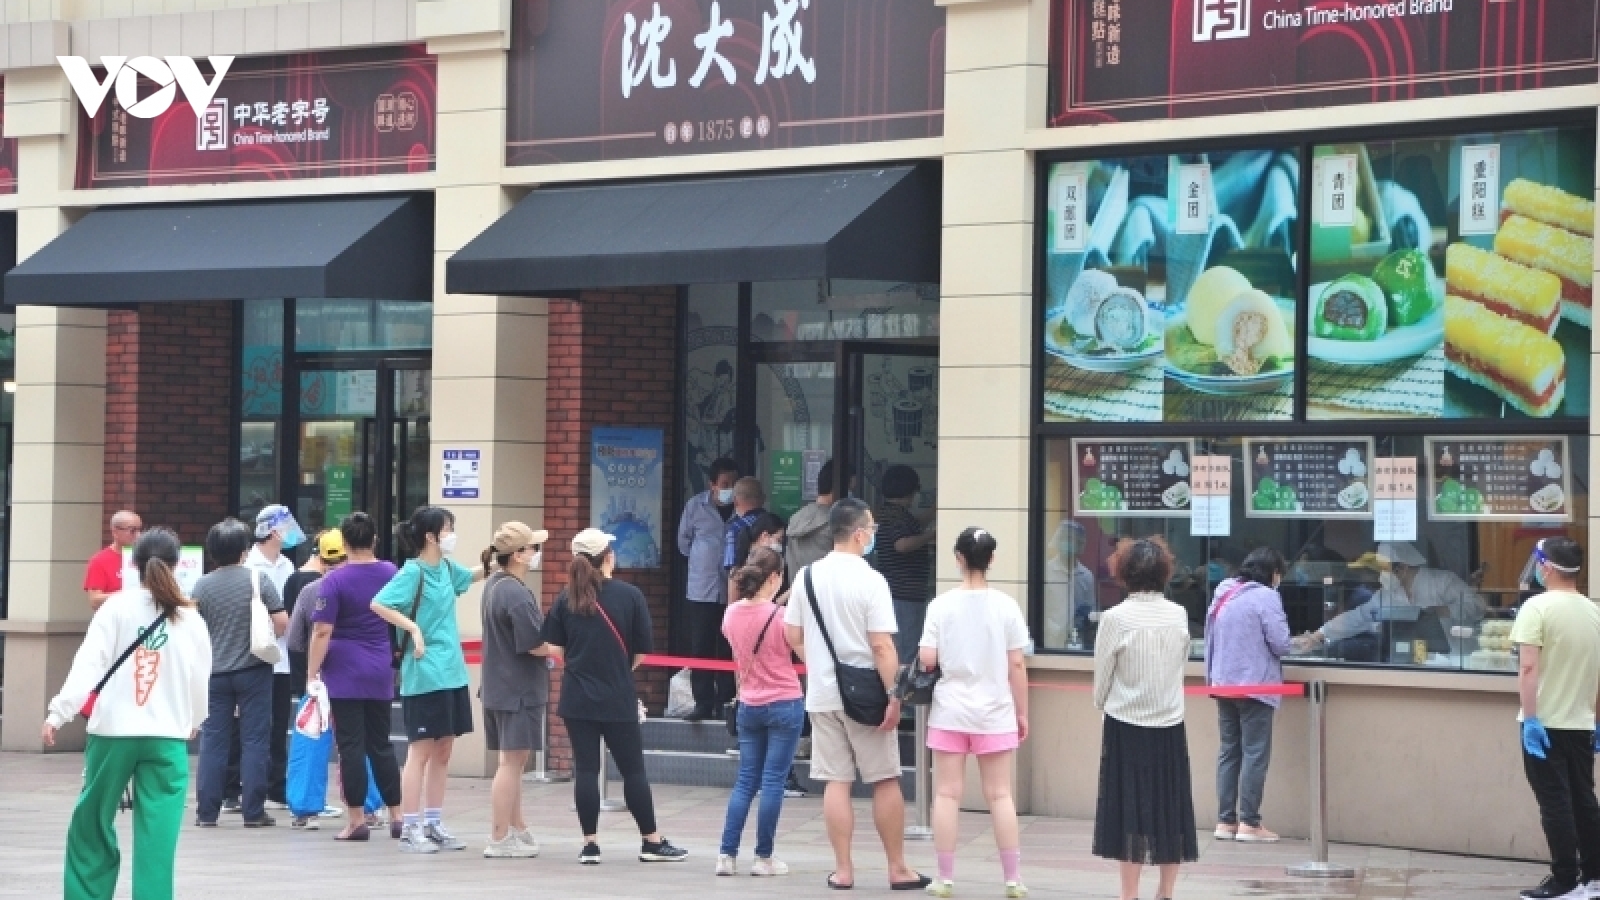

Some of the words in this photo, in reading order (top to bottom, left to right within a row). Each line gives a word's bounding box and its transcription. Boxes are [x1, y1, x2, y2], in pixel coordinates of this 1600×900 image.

[1262, 8, 1303, 30] China
[1304, 0, 1407, 25] Time-honored
[621, 0, 818, 99] 沈大成
[233, 98, 330, 127] 中华老字号
[232, 131, 255, 146] China
[254, 128, 307, 144] Time-honored
[307, 126, 331, 142] Brand
[697, 118, 734, 143] 1875
[1331, 172, 1345, 211] 青团
